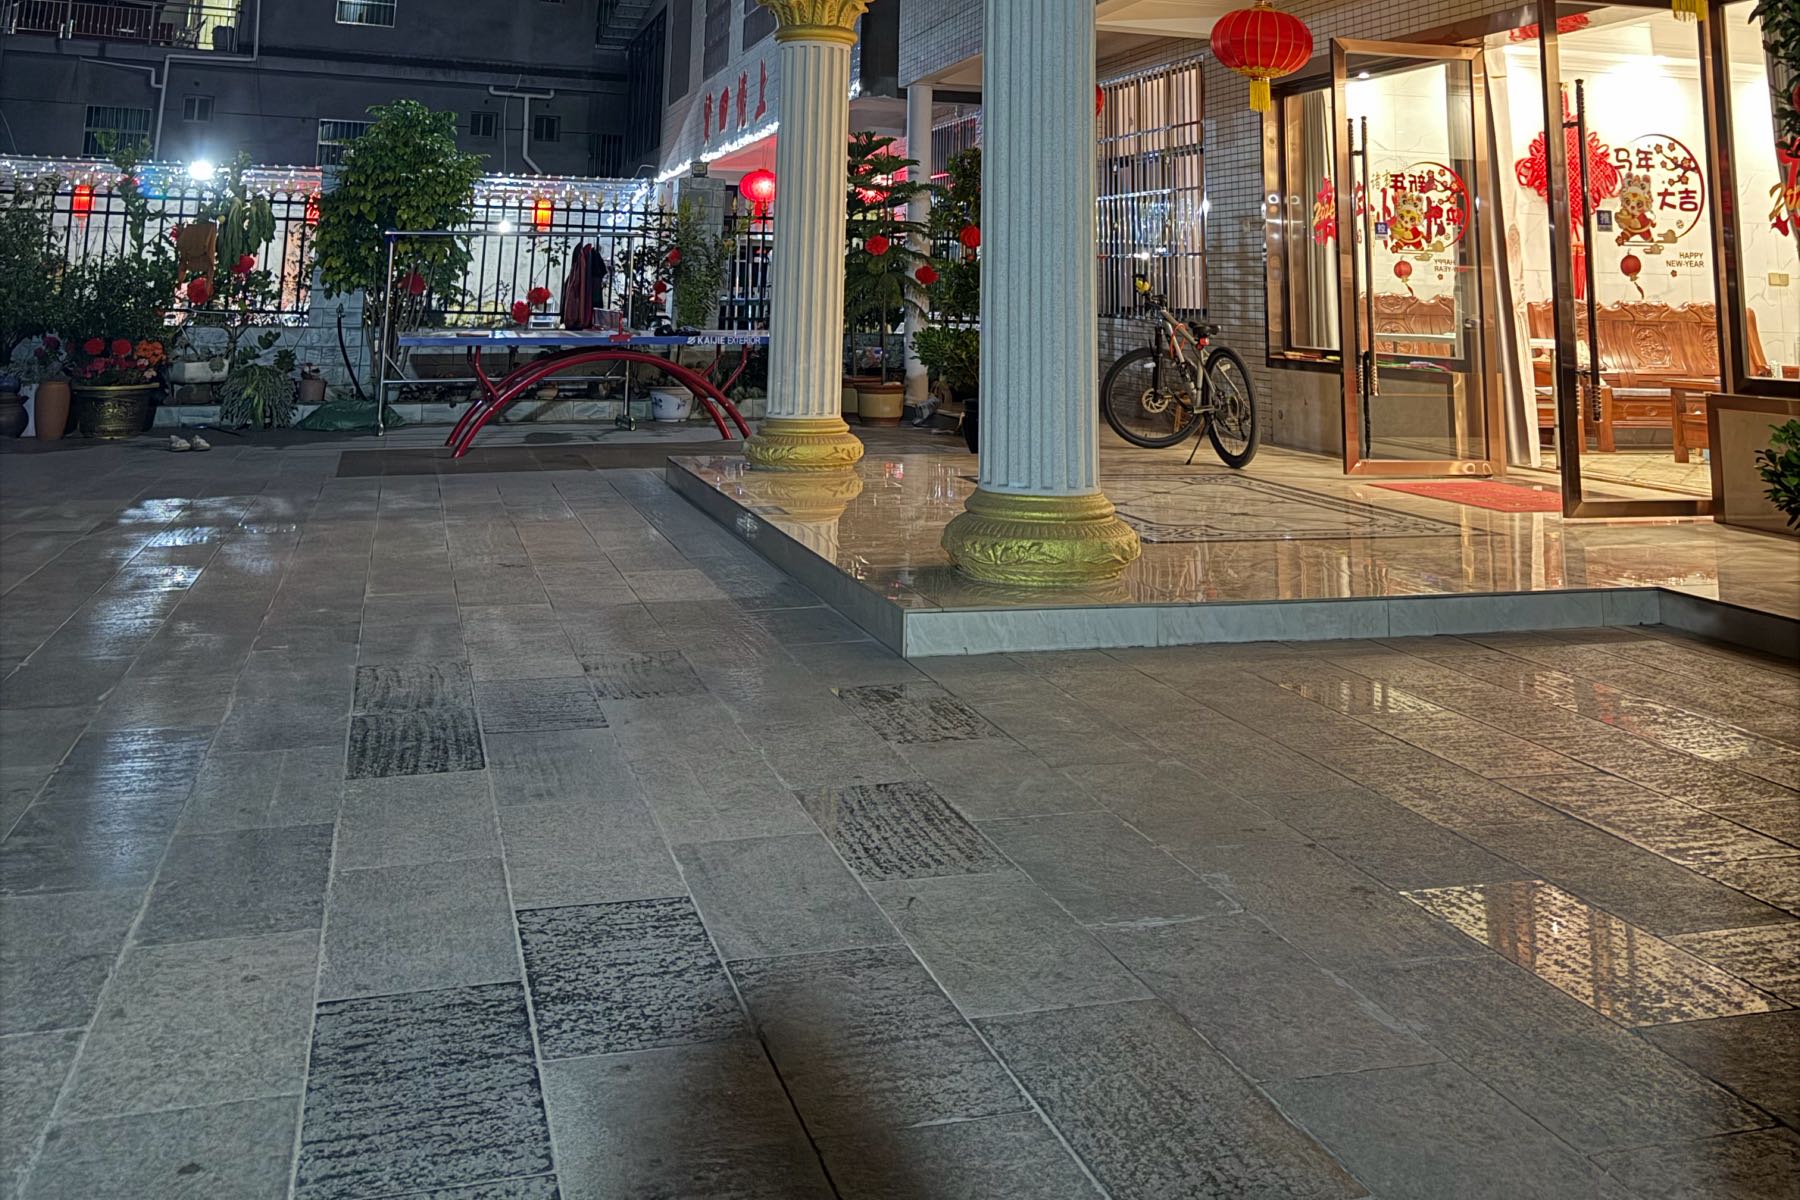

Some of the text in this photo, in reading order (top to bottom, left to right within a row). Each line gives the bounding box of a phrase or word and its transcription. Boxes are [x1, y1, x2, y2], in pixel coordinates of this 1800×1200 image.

[1614, 148, 1655, 172] 马年
[1657, 188, 1698, 212] 大吉
[1666, 260, 1704, 268] NEW-YEAR
[697, 336, 761, 345] KAIJIE EXTERIOR
